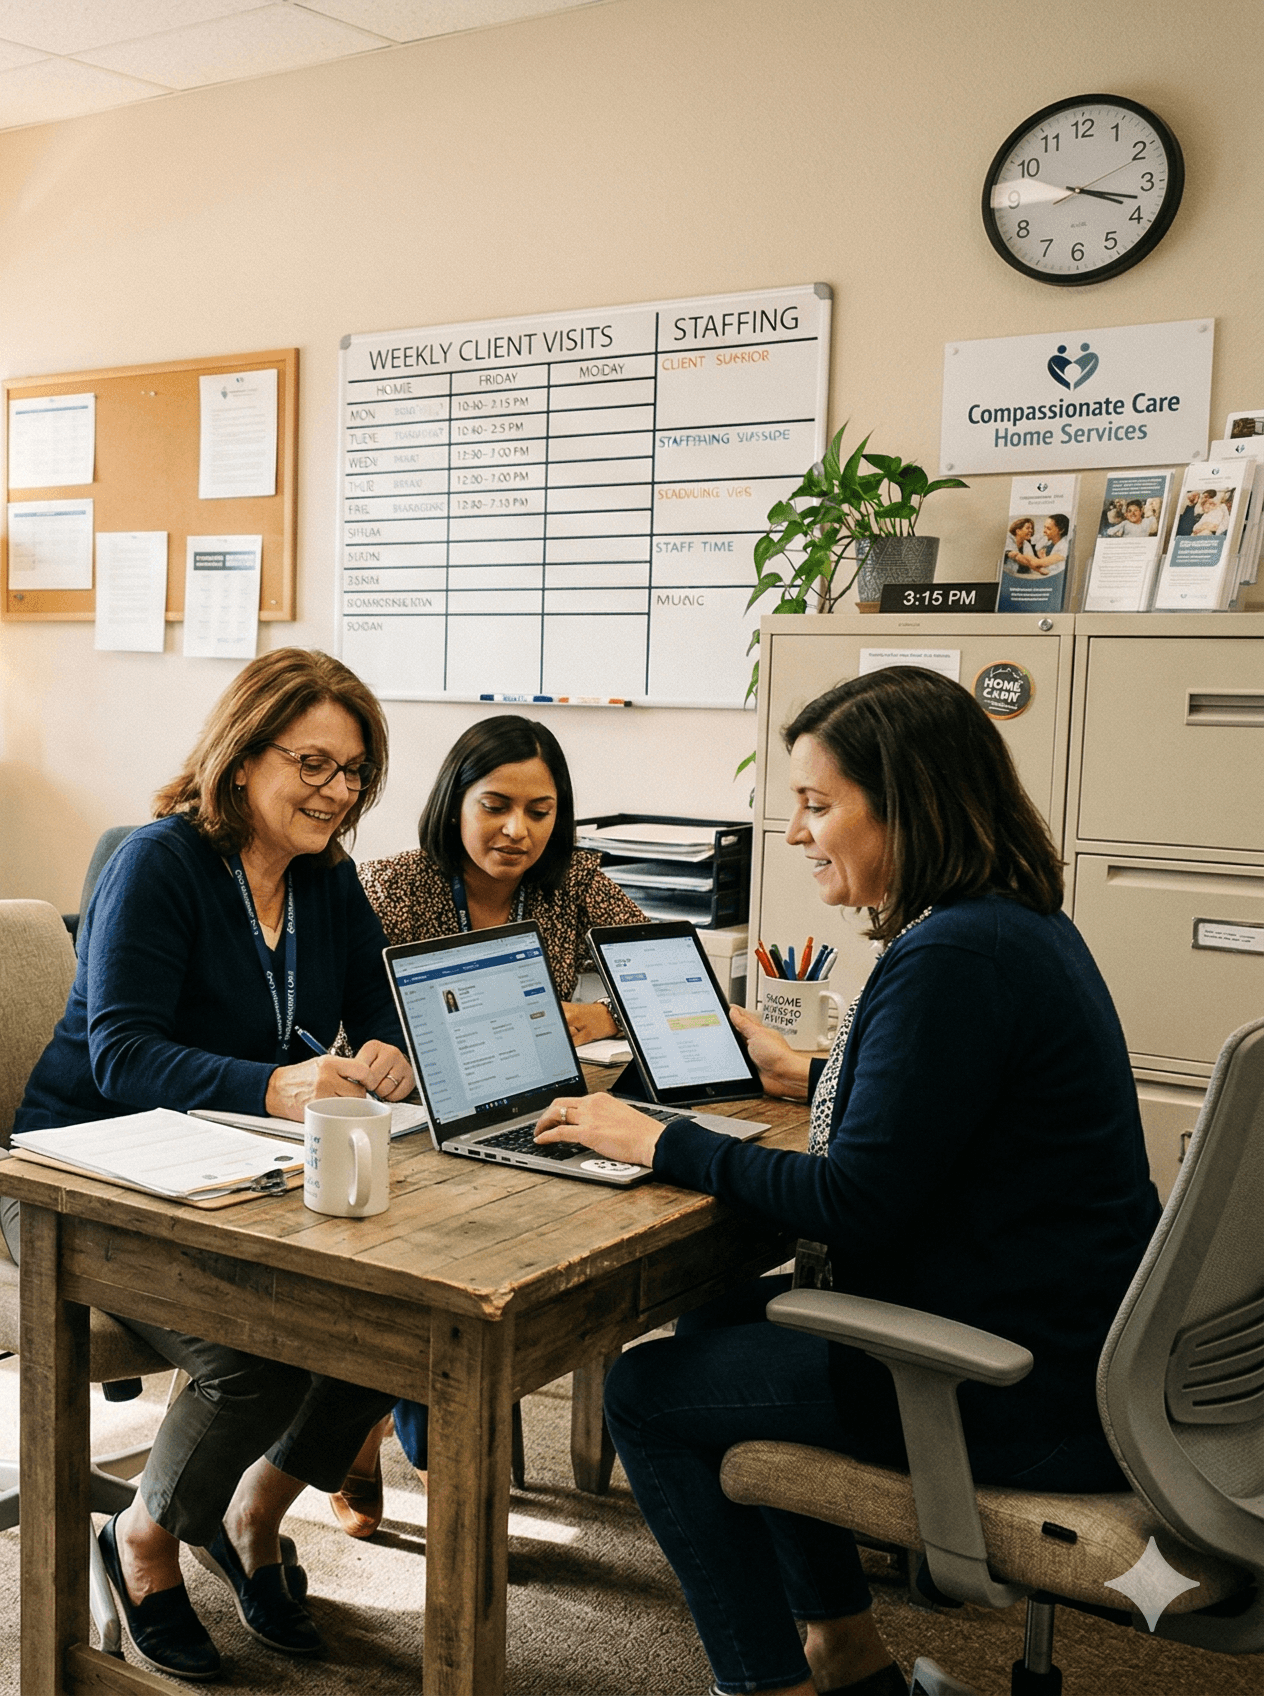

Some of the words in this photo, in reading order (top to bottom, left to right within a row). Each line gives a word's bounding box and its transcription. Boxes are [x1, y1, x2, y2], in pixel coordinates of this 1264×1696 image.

[1071, 118, 1095, 139] 12
[1110, 122, 1120, 142] 1
[1040, 133, 1061, 153] 11
[1131, 140, 1147, 161] 2
[1017, 158, 1040, 178] 10
[1140, 171, 1155, 192] 3
[1007, 190, 1021, 209] 9
[1128, 205, 1143, 224] 4
[1016, 219, 1030, 238] 8
[1040, 238, 1054, 257] 7
[1103, 230, 1118, 250] 5
[1071, 242, 1085, 261] 6
[674, 305, 800, 341] STAFFING
[369, 342, 453, 371] WEEKLY
[459, 333, 537, 361] CLIENT
[543, 325, 613, 353] VISITS
[662, 355, 706, 371] CLIENT
[479, 373, 518, 386] FRIDAY
[350, 409, 376, 421] MON
[968, 398, 1125, 427] Compassionate
[1132, 392, 1181, 414] Care
[509, 422, 523, 432] PM
[994, 427, 1054, 448] Home
[1060, 420, 1148, 445] Services
[655, 541, 694, 553] STAFF
[701, 541, 734, 553] TIME
[903, 590, 943, 606] 3:15
[948, 590, 976, 605] PM
[984, 677, 1022, 692] HOME
